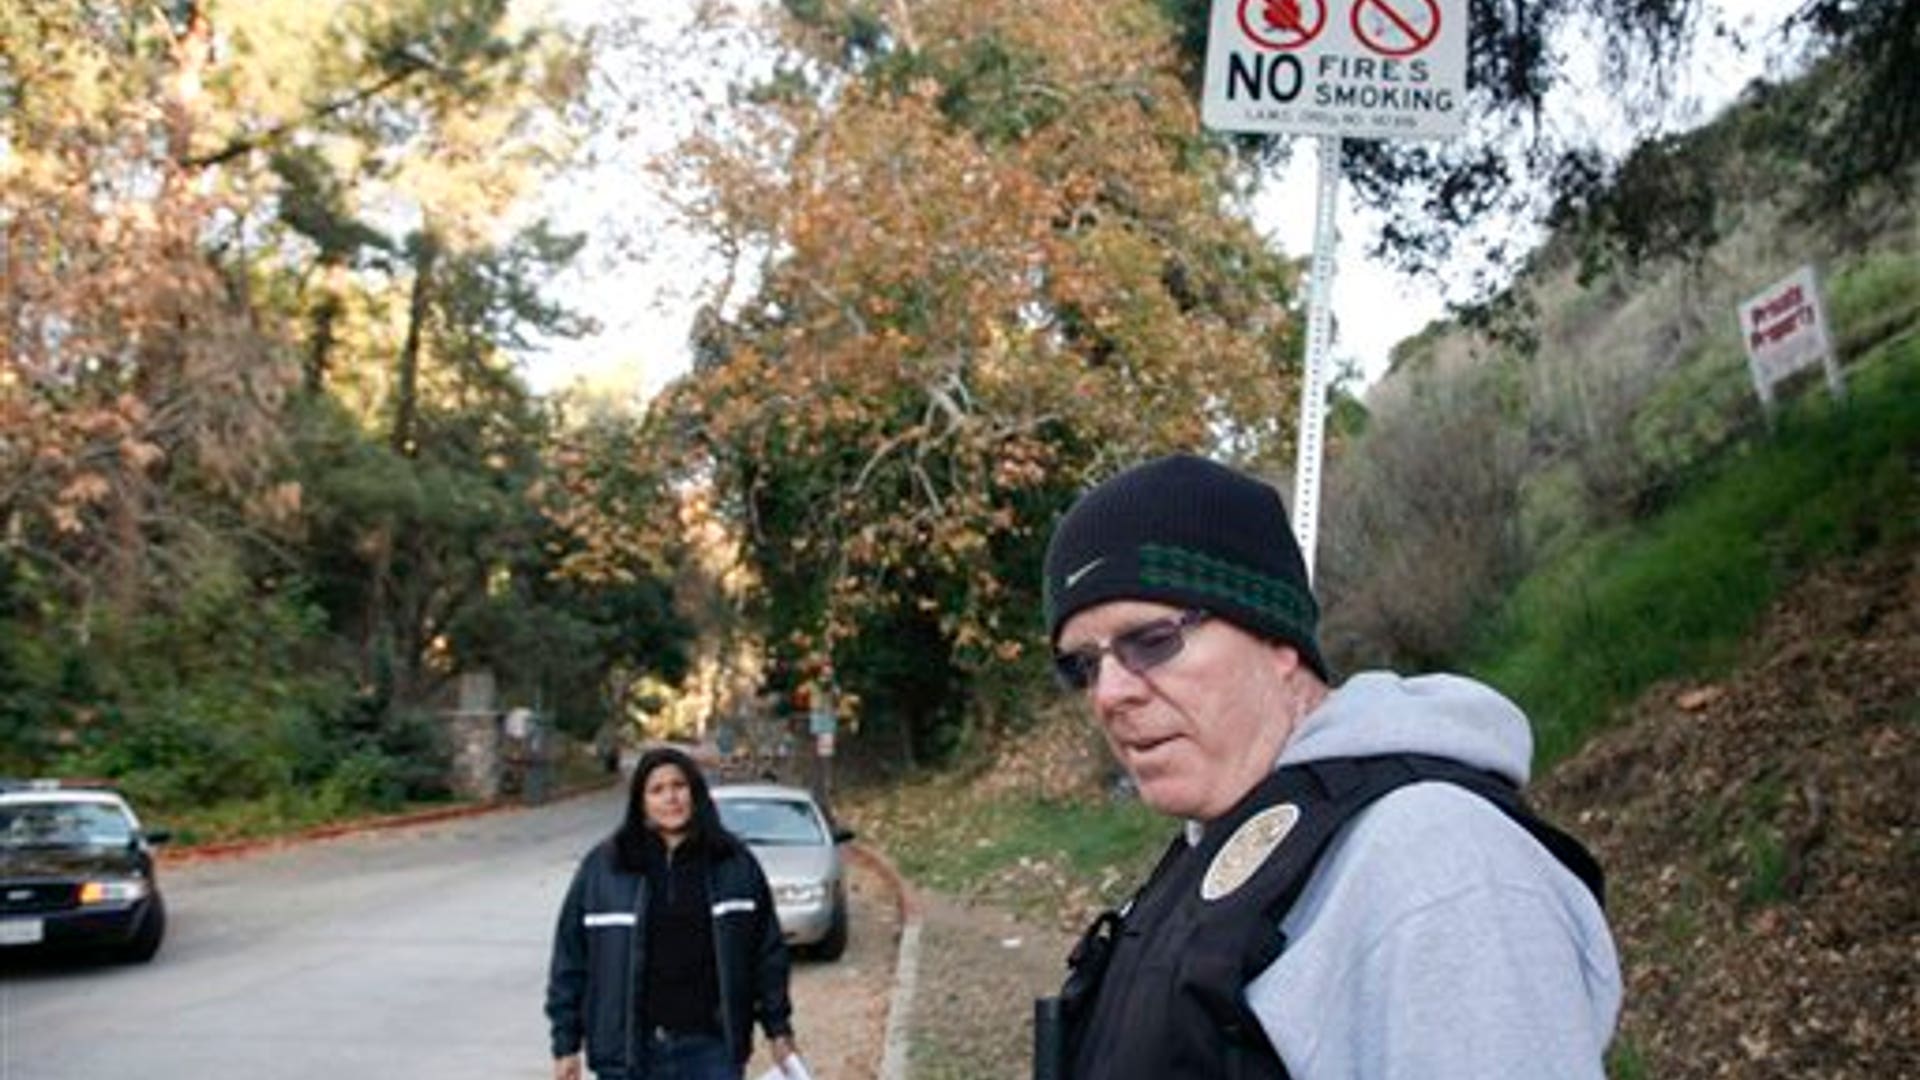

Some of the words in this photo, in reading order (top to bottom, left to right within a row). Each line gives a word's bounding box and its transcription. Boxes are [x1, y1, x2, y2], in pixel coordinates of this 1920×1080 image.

[1227, 53, 1303, 103] NO
[1318, 55, 1430, 82] FIRES
[1315, 83, 1453, 112] SMOKING
